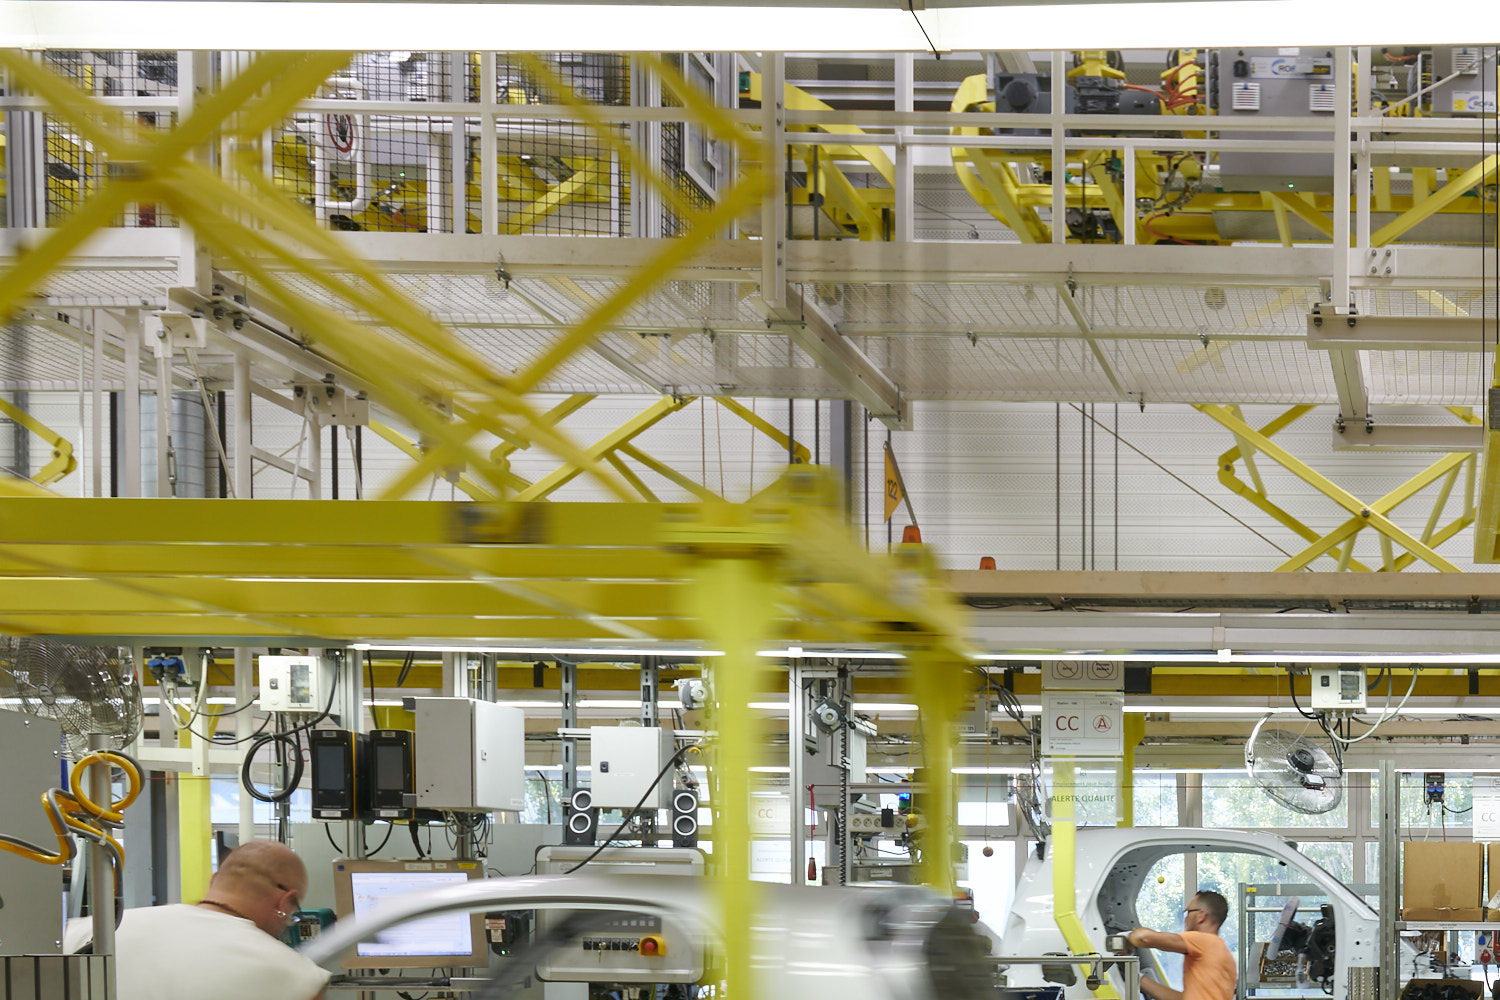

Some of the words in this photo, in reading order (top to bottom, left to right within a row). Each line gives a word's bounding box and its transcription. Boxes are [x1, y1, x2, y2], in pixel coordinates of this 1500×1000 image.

[1056, 715, 1079, 731] CC
[758, 808, 773, 819] CC
[1481, 812, 1496, 822] CC
